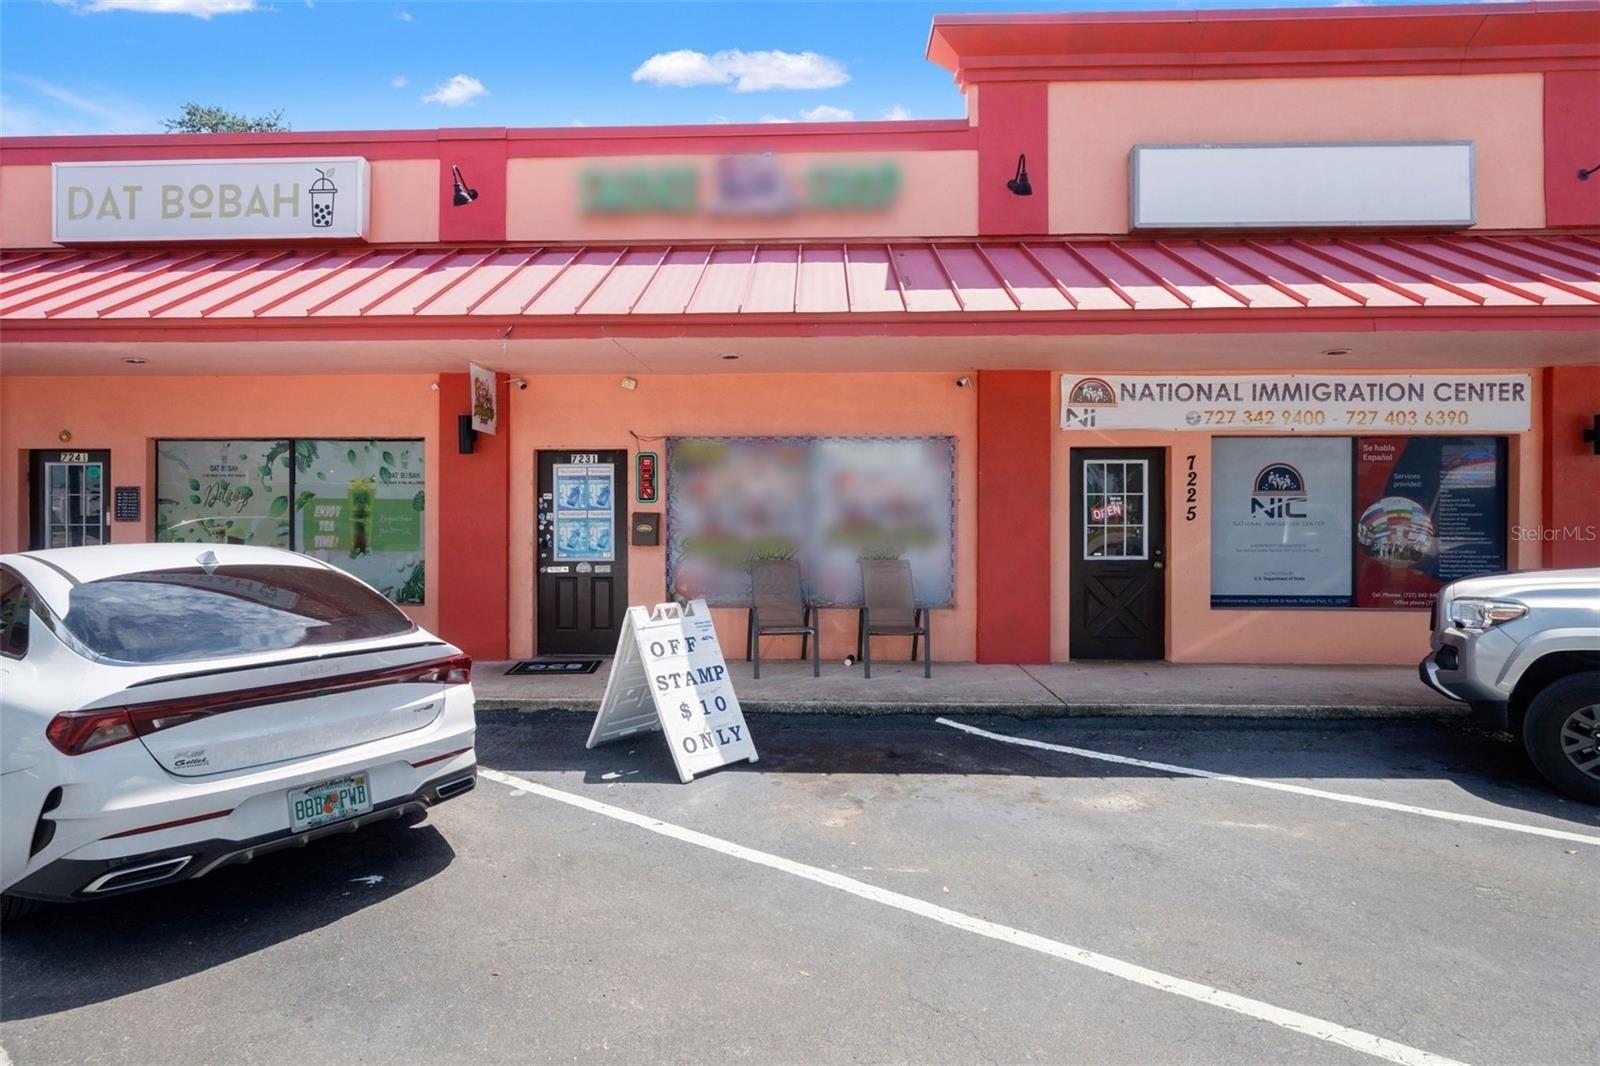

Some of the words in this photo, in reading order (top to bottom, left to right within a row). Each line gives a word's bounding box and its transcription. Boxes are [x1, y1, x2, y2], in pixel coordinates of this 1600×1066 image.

[68, 185, 142, 220] DAT
[161, 183, 300, 219] BOBAH
[1120, 382, 1243, 402] NATIONAL
[1252, 382, 1425, 402] IMMIGRATION
[1433, 382, 1525, 402] CENTER
[1204, 410, 1236, 425] 727
[1243, 410, 1275, 425] 342
[1282, 410, 1326, 425] 9400
[1346, 410, 1378, 425] 727
[1384, 410, 1418, 425] 403
[1424, 410, 1469, 425] 6390
[1374, 443, 1395, 451] habla
[61, 453, 88, 462] 7241
[571, 454, 598, 463] 7231
[1363, 453, 1393, 462] Español
[1186, 455, 1198, 521] 7225
[314, 505, 342, 517] ENJOY
[1251, 497, 1307, 518] NIC
[650, 636, 697, 657] OFF
[656, 665, 724, 691] STAMP
[682, 725, 742, 754] ONLY
